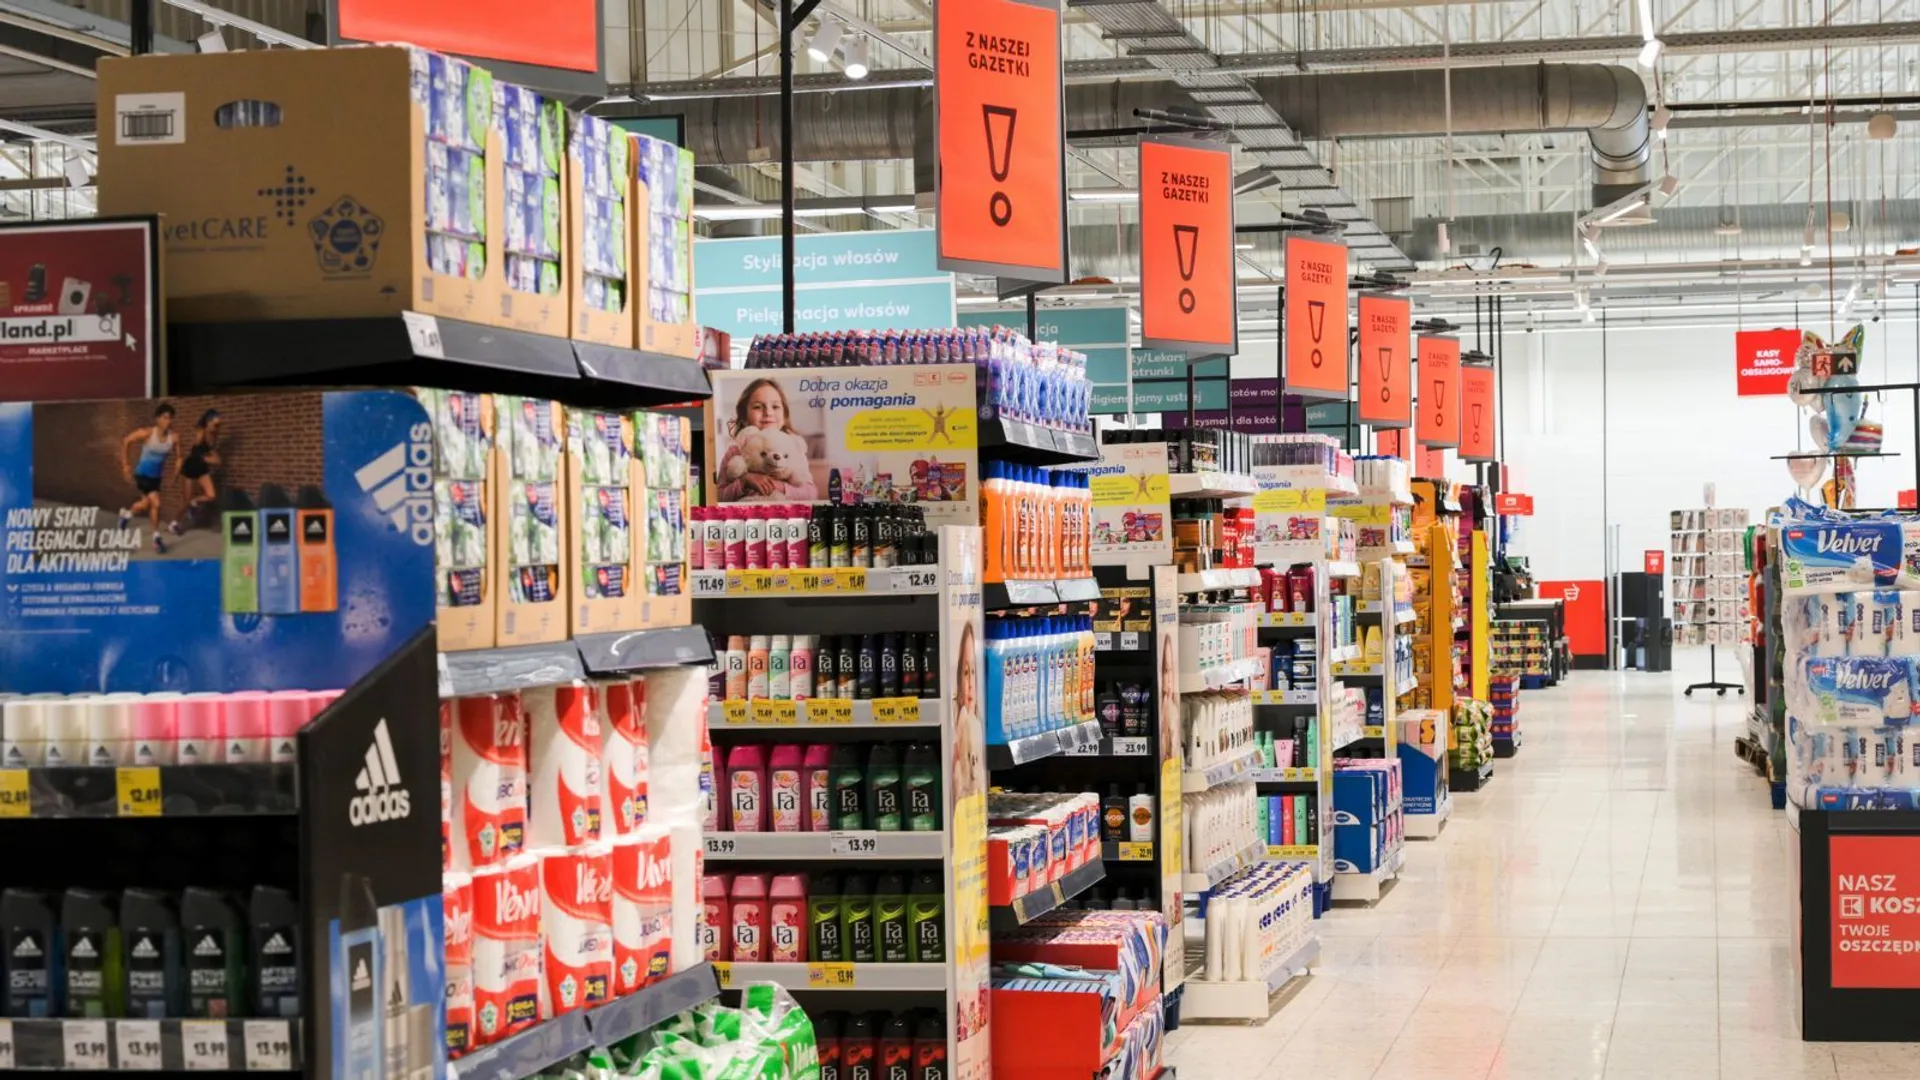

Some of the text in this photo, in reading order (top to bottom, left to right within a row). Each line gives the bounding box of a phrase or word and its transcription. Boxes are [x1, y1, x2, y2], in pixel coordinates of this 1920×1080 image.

[966, 31, 1030, 57] Z NASZEJ
[967, 52, 1030, 78] GAZETKI
[1161, 171, 1209, 189] Z NASZEJ
[1163, 186, 1209, 204] GAZETKI
[743, 249, 899, 273] Styliacja włosów
[1301, 260, 1333, 274] Z NASZEJ
[1301, 273, 1332, 286] GAZETKI
[736, 302, 910, 326] Pielęnacja włosów
[1756, 349, 1781, 358] KASY
[799, 377, 889, 394] Dobra okazja
[808, 392, 916, 411] do pomagania
[1236, 415, 1252, 425] dla
[404, 421, 434, 546] adidas
[6, 506, 99, 529] NOWY START
[708, 525, 721, 540] Fa
[746, 525, 759, 539] Fa
[769, 524, 783, 539] Fa
[6, 528, 142, 553] PIELĘGNACJI CIAŁA
[1817, 529, 1883, 554] Velvet
[6, 551, 129, 574] DLA AKTYWNYCH
[699, 578, 724, 591] 11.49
[908, 573, 936, 586] 12.49
[730, 656, 743, 670] Fa
[750, 656, 763, 670] Fa
[771, 656, 784, 670] Fa
[793, 656, 807, 670] Fa
[819, 655, 832, 669] Fa
[840, 654, 853, 669] Fa
[860, 654, 873, 668] Fa
[882, 654, 895, 668] Fa
[902, 653, 915, 668] Fa
[1836, 661, 1894, 690] Velvet
[1125, 743, 1146, 753] 23.99
[737, 792, 754, 811] Fa
[778, 791, 795, 810] Fa
[842, 789, 858, 806] Fa
[878, 789, 895, 807] Fa
[912, 790, 929, 807] Fa
[349, 785, 411, 826] adidas
[707, 840, 734, 852] 13.99
[848, 839, 875, 851] 13.99
[1838, 874, 1897, 892] NASZ
[737, 925, 754, 944] Fa
[776, 925, 793, 944] Fa
[821, 921, 837, 939] Fa
[855, 921, 871, 939] Fa
[885, 921, 902, 939] Fa
[921, 921, 938, 939] Fa
[1839, 924, 1890, 937] TWOJE
[75, 1042, 106, 1057] 13.99
[128, 1041, 160, 1057] 13.99
[194, 1041, 226, 1056] 13.99
[256, 1041, 290, 1056] 13.99
[822, 1065, 837, 1080] Fa
[853, 1065, 869, 1080] Fa
[890, 1066, 907, 1080] Fa
[925, 1066, 941, 1080] Fa
